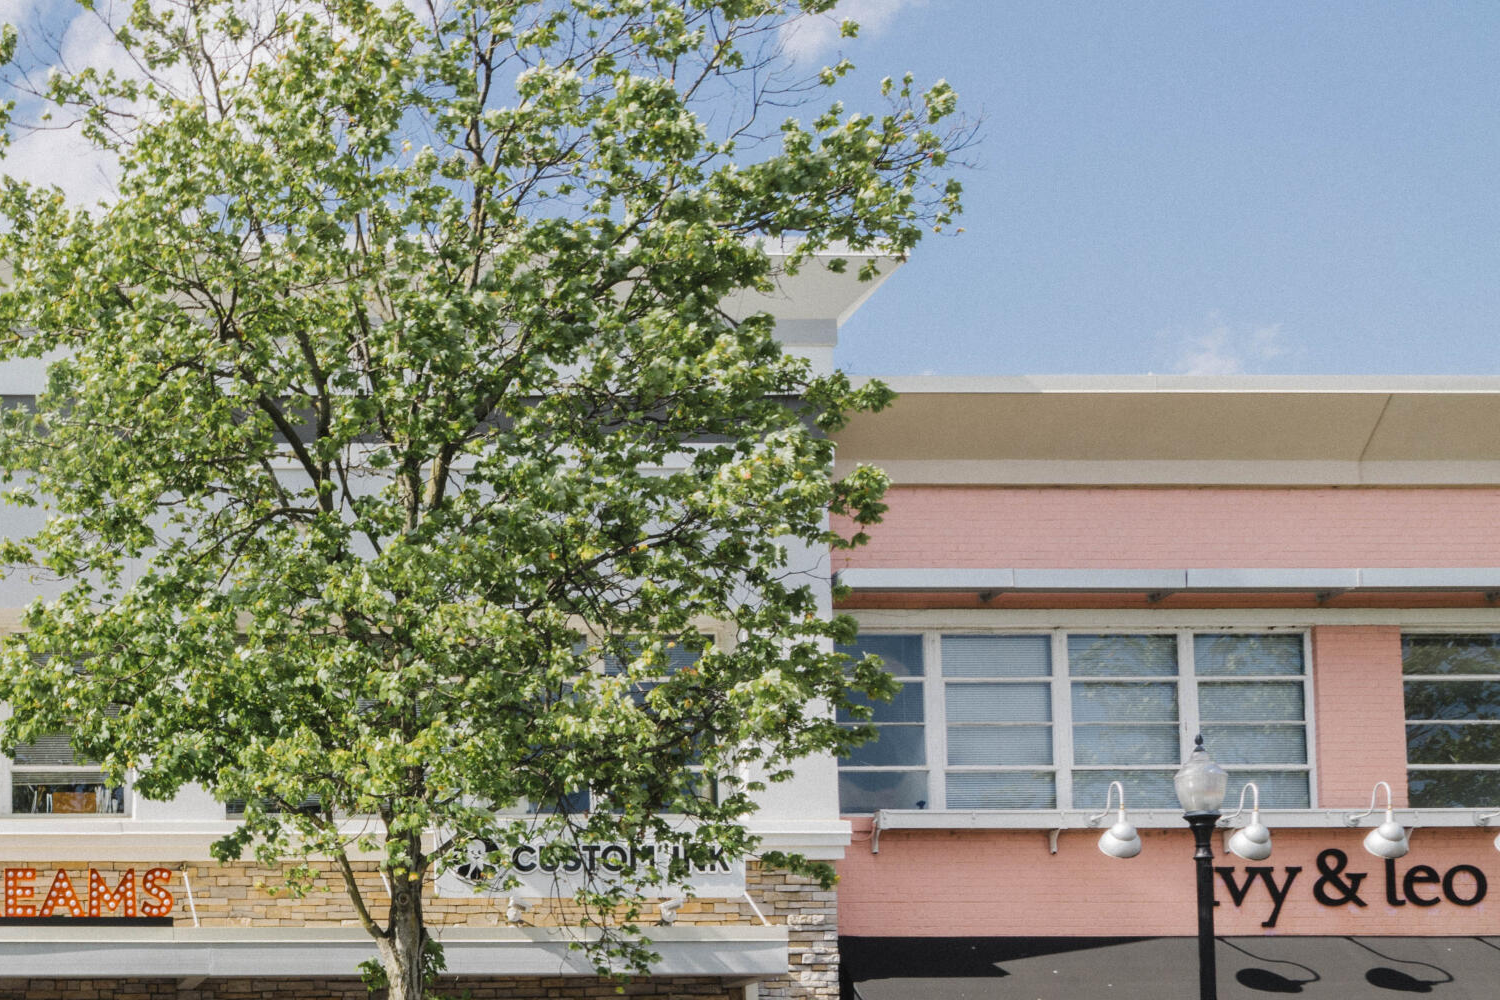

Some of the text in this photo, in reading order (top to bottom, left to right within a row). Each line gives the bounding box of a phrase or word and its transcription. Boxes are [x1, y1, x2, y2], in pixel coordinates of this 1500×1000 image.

[1213, 848, 1488, 928] vy & leo
